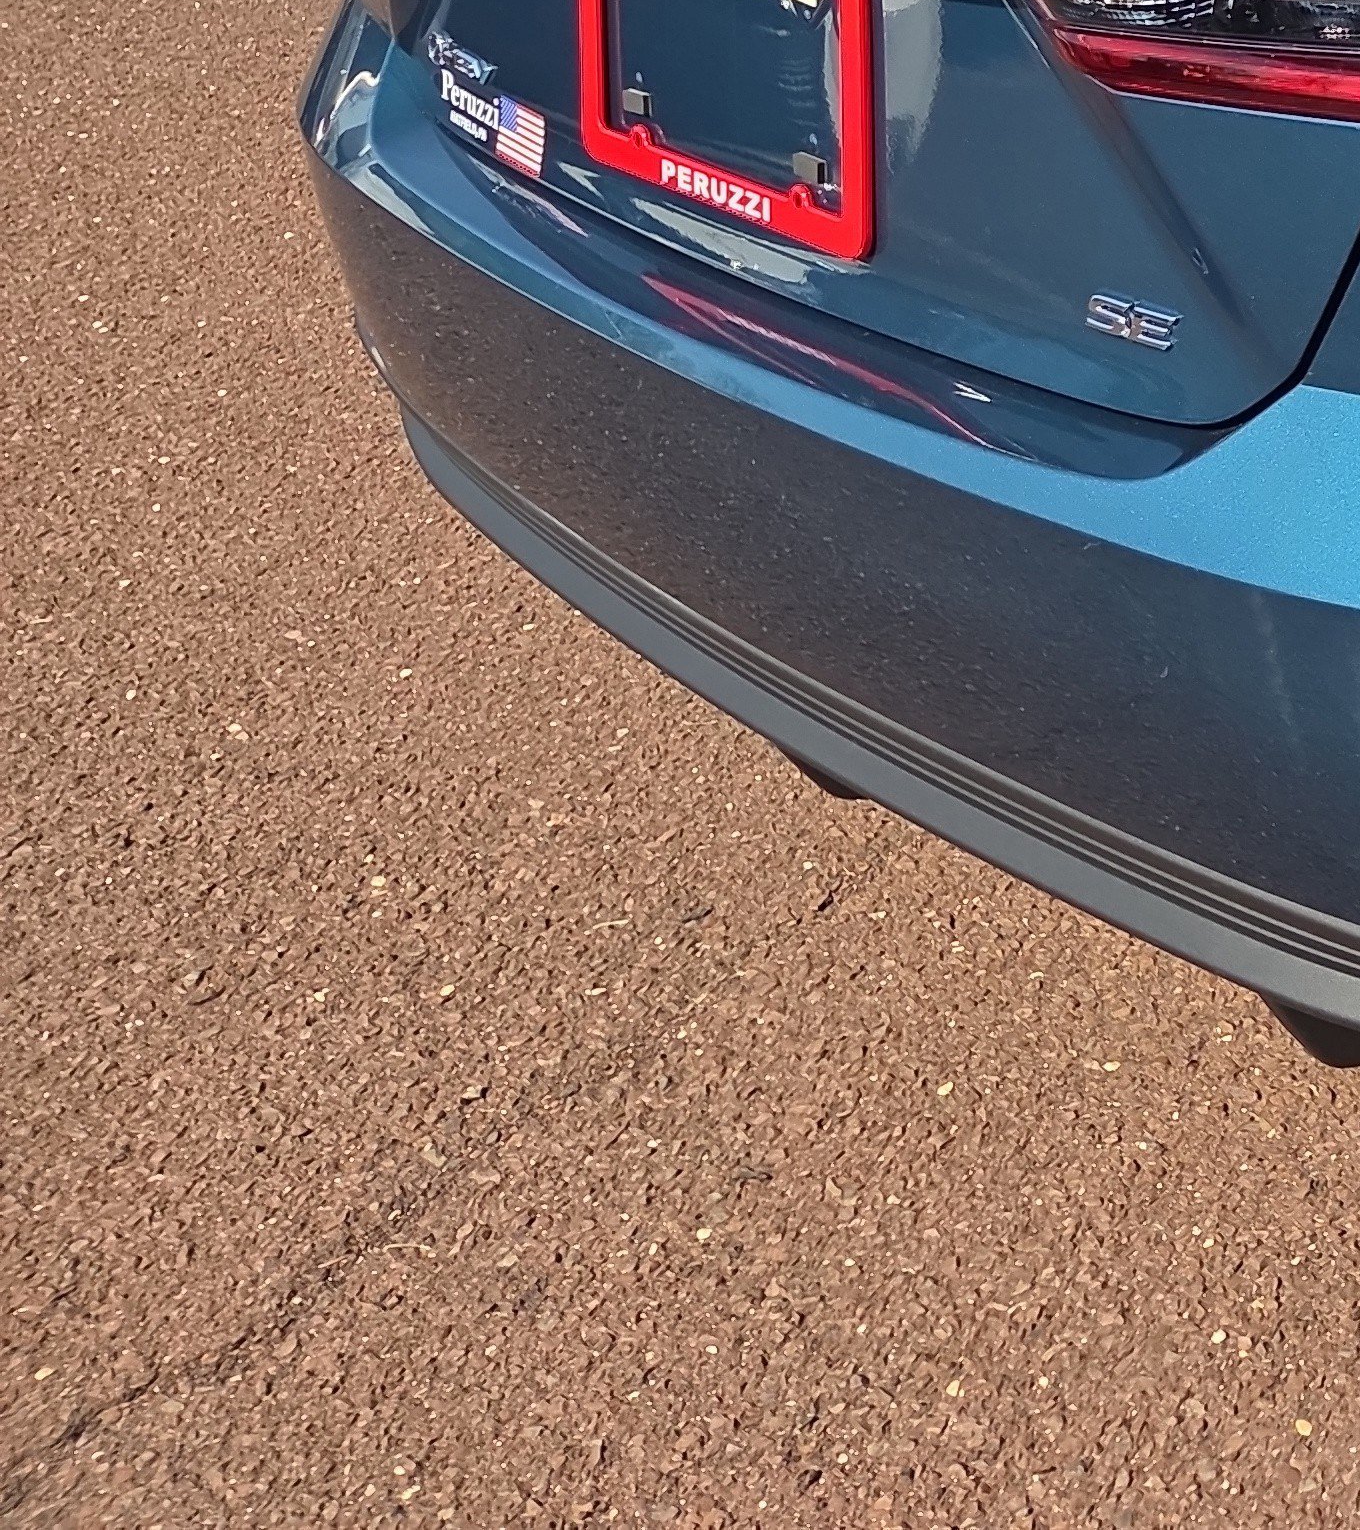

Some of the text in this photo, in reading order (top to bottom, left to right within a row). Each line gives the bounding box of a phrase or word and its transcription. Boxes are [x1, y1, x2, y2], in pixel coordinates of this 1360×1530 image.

[440, 68, 500, 132] Peruzzi
[661, 158, 771, 223] PERUZZI
[1085, 292, 1184, 351] SE
